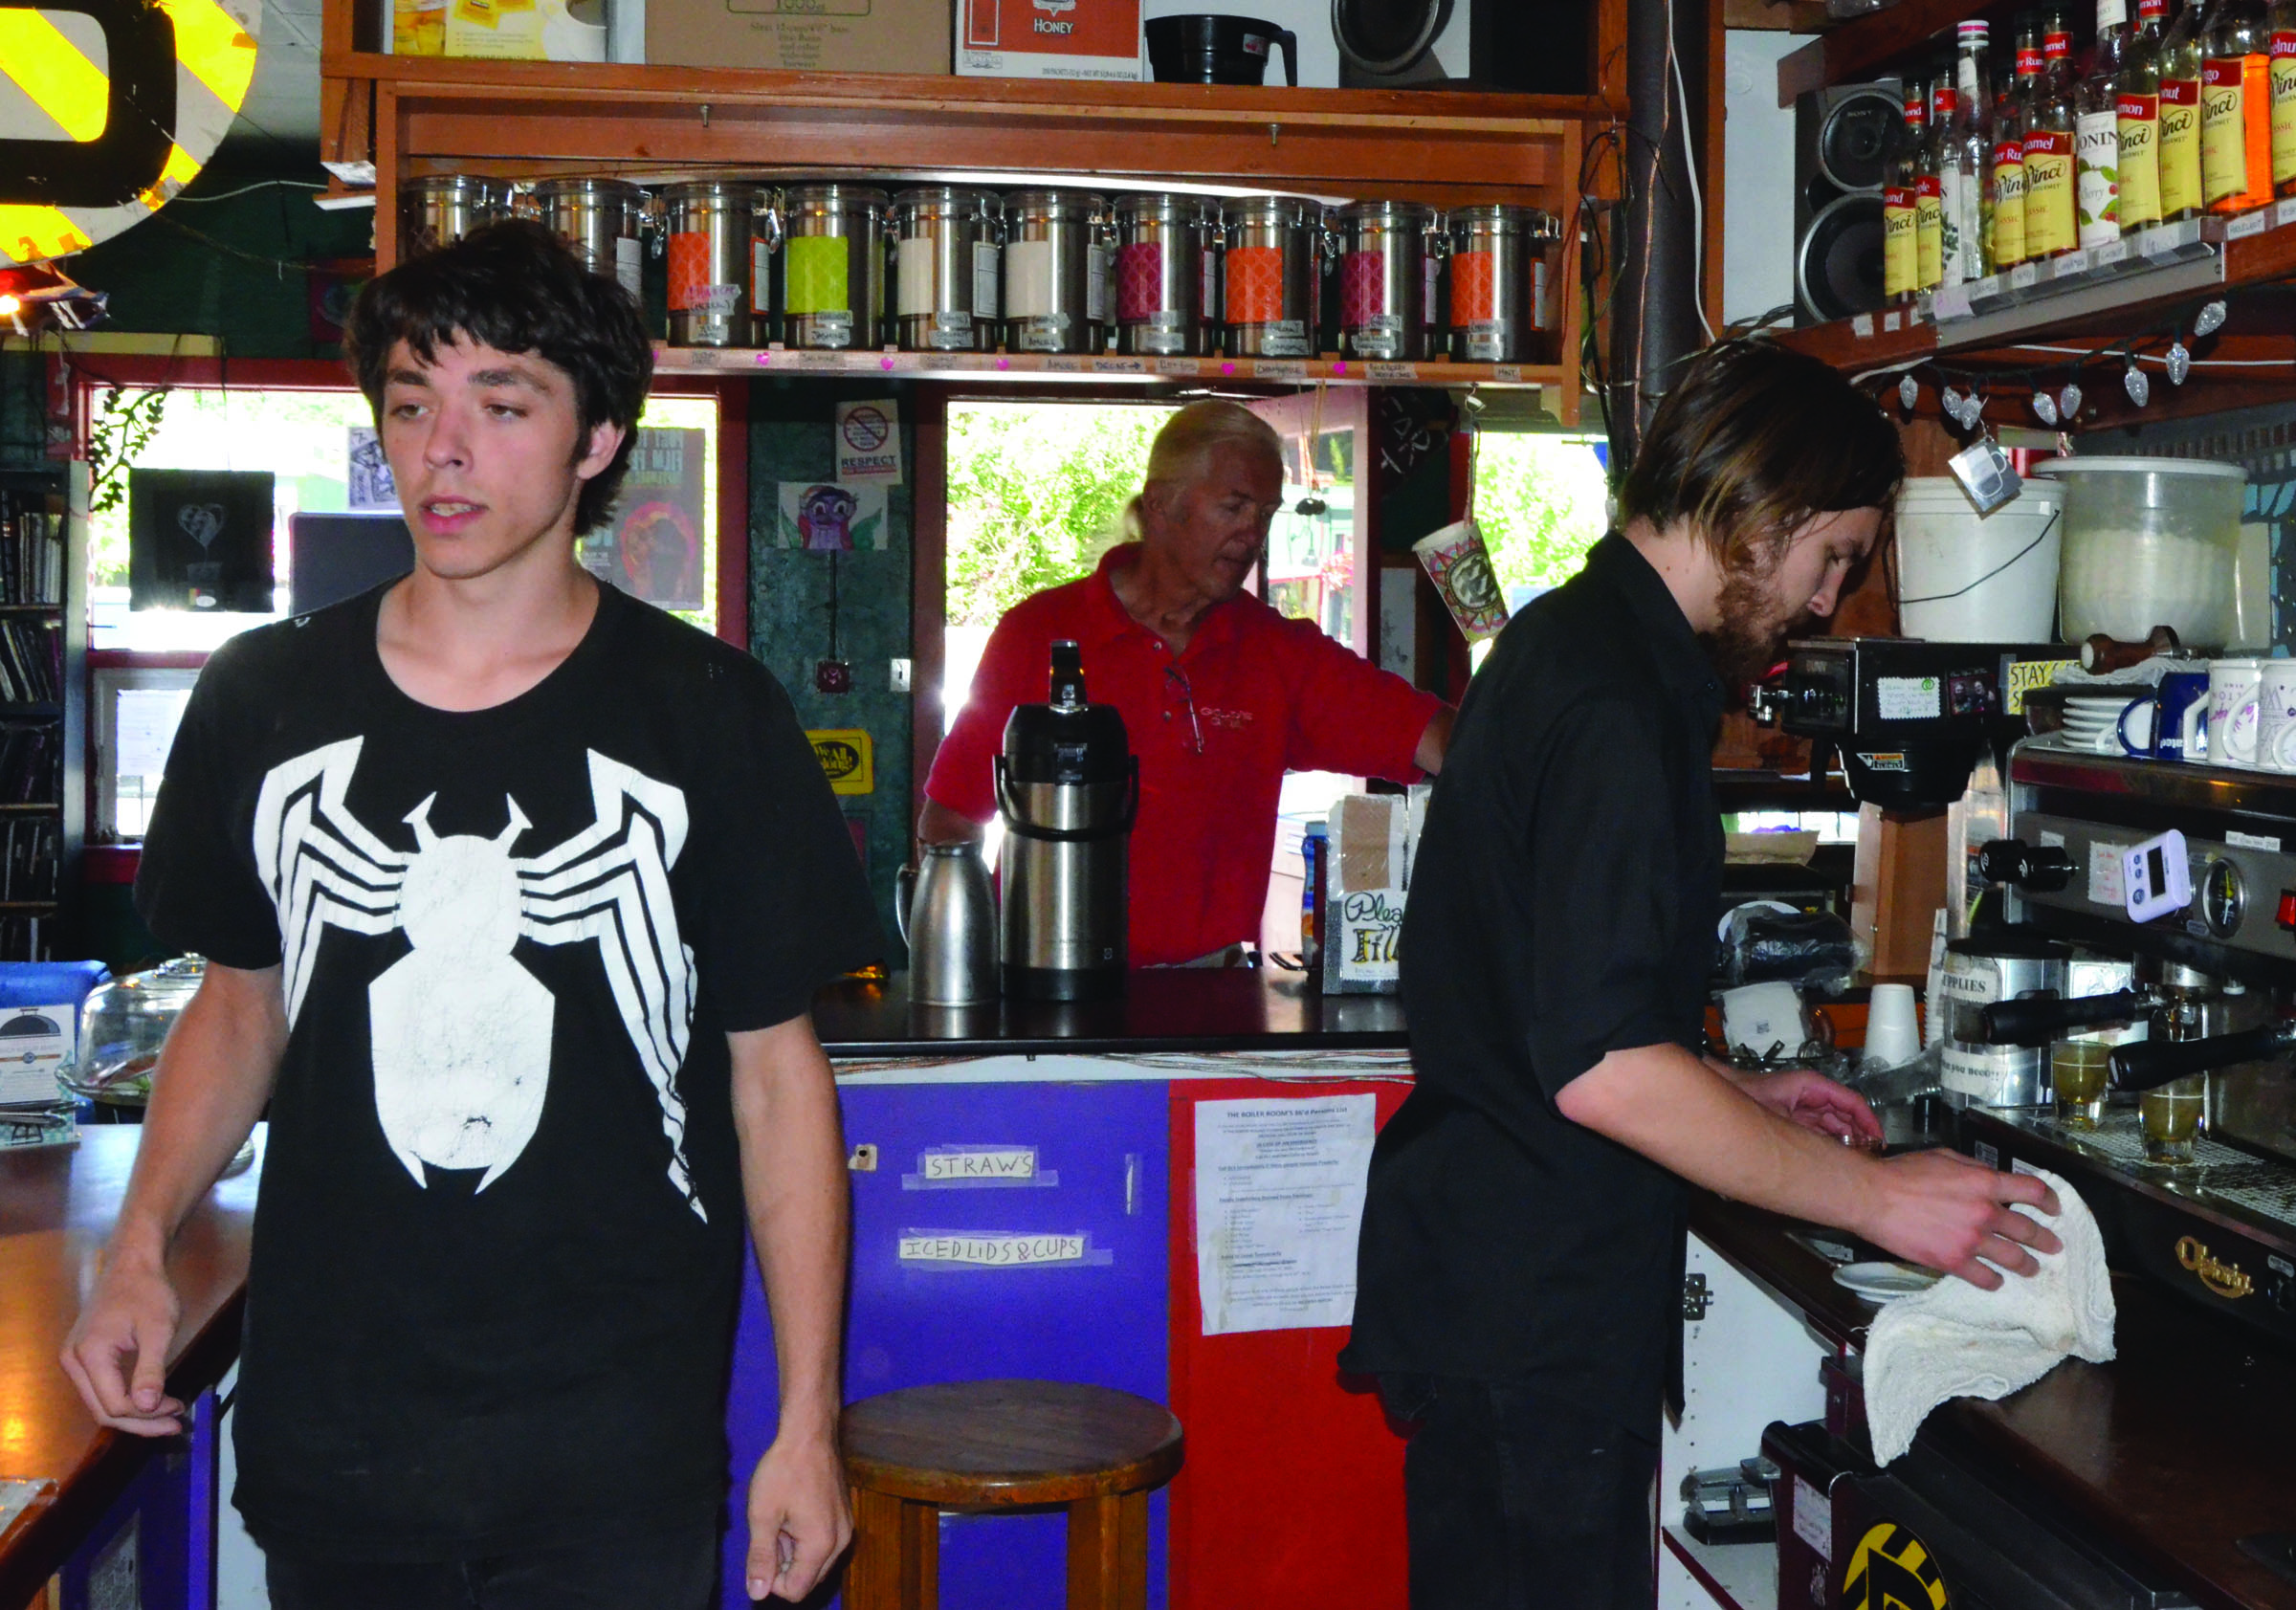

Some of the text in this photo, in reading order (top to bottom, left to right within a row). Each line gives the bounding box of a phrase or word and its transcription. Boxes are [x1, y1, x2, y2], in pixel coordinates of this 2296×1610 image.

[1033, 18, 1073, 34] HONEY
[841, 454, 896, 467] RESPECT
[2011, 664, 2048, 687] STAY
